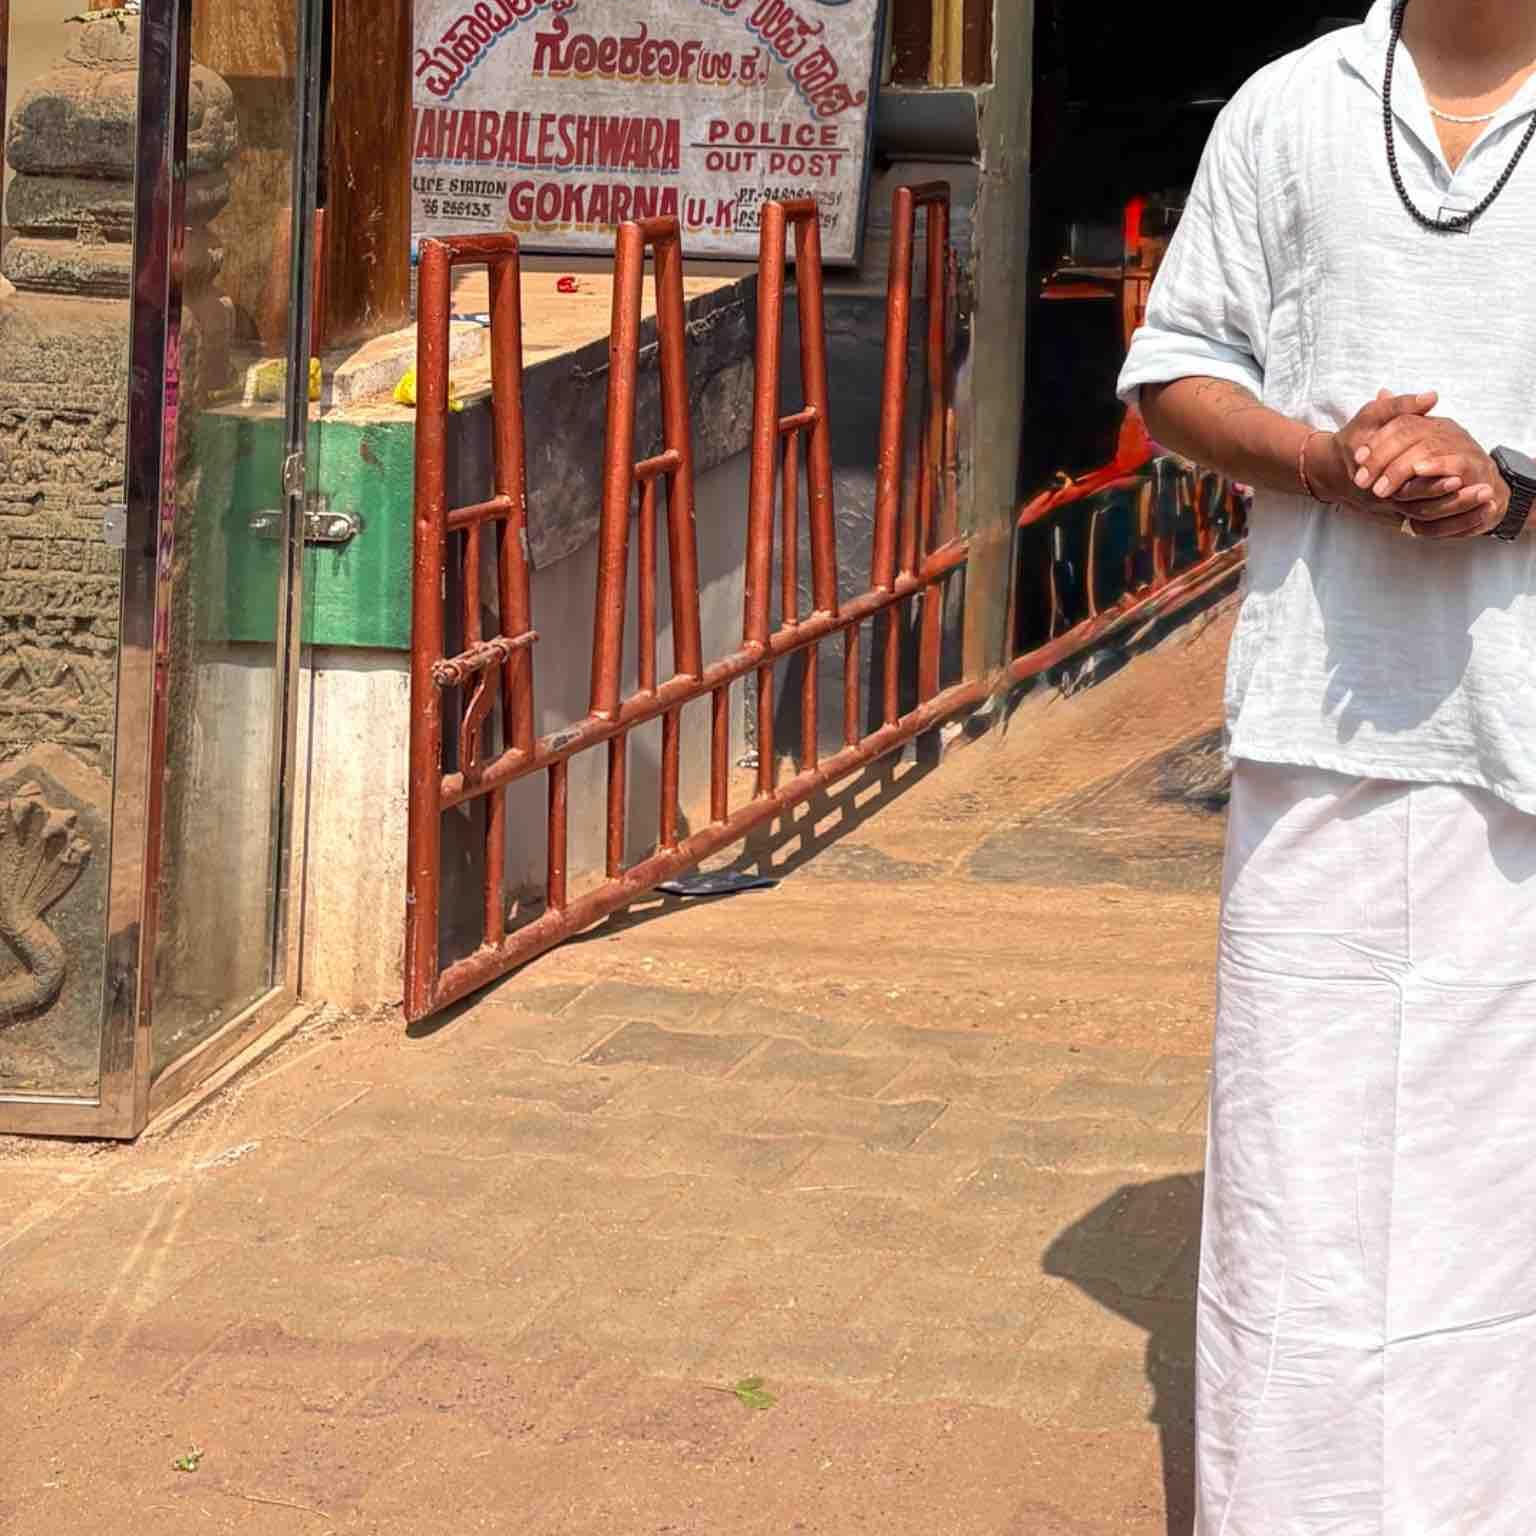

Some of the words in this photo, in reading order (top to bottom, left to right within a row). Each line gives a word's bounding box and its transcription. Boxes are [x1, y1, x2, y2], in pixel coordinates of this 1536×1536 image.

[412, 107, 681, 170] AHABALESHWARA
[708, 120, 839, 147] POLICE
[705, 151, 758, 173] OUT
[769, 152, 843, 177] POST
[449, 178, 507, 196] STATION
[508, 180, 680, 225] GOKARNA
